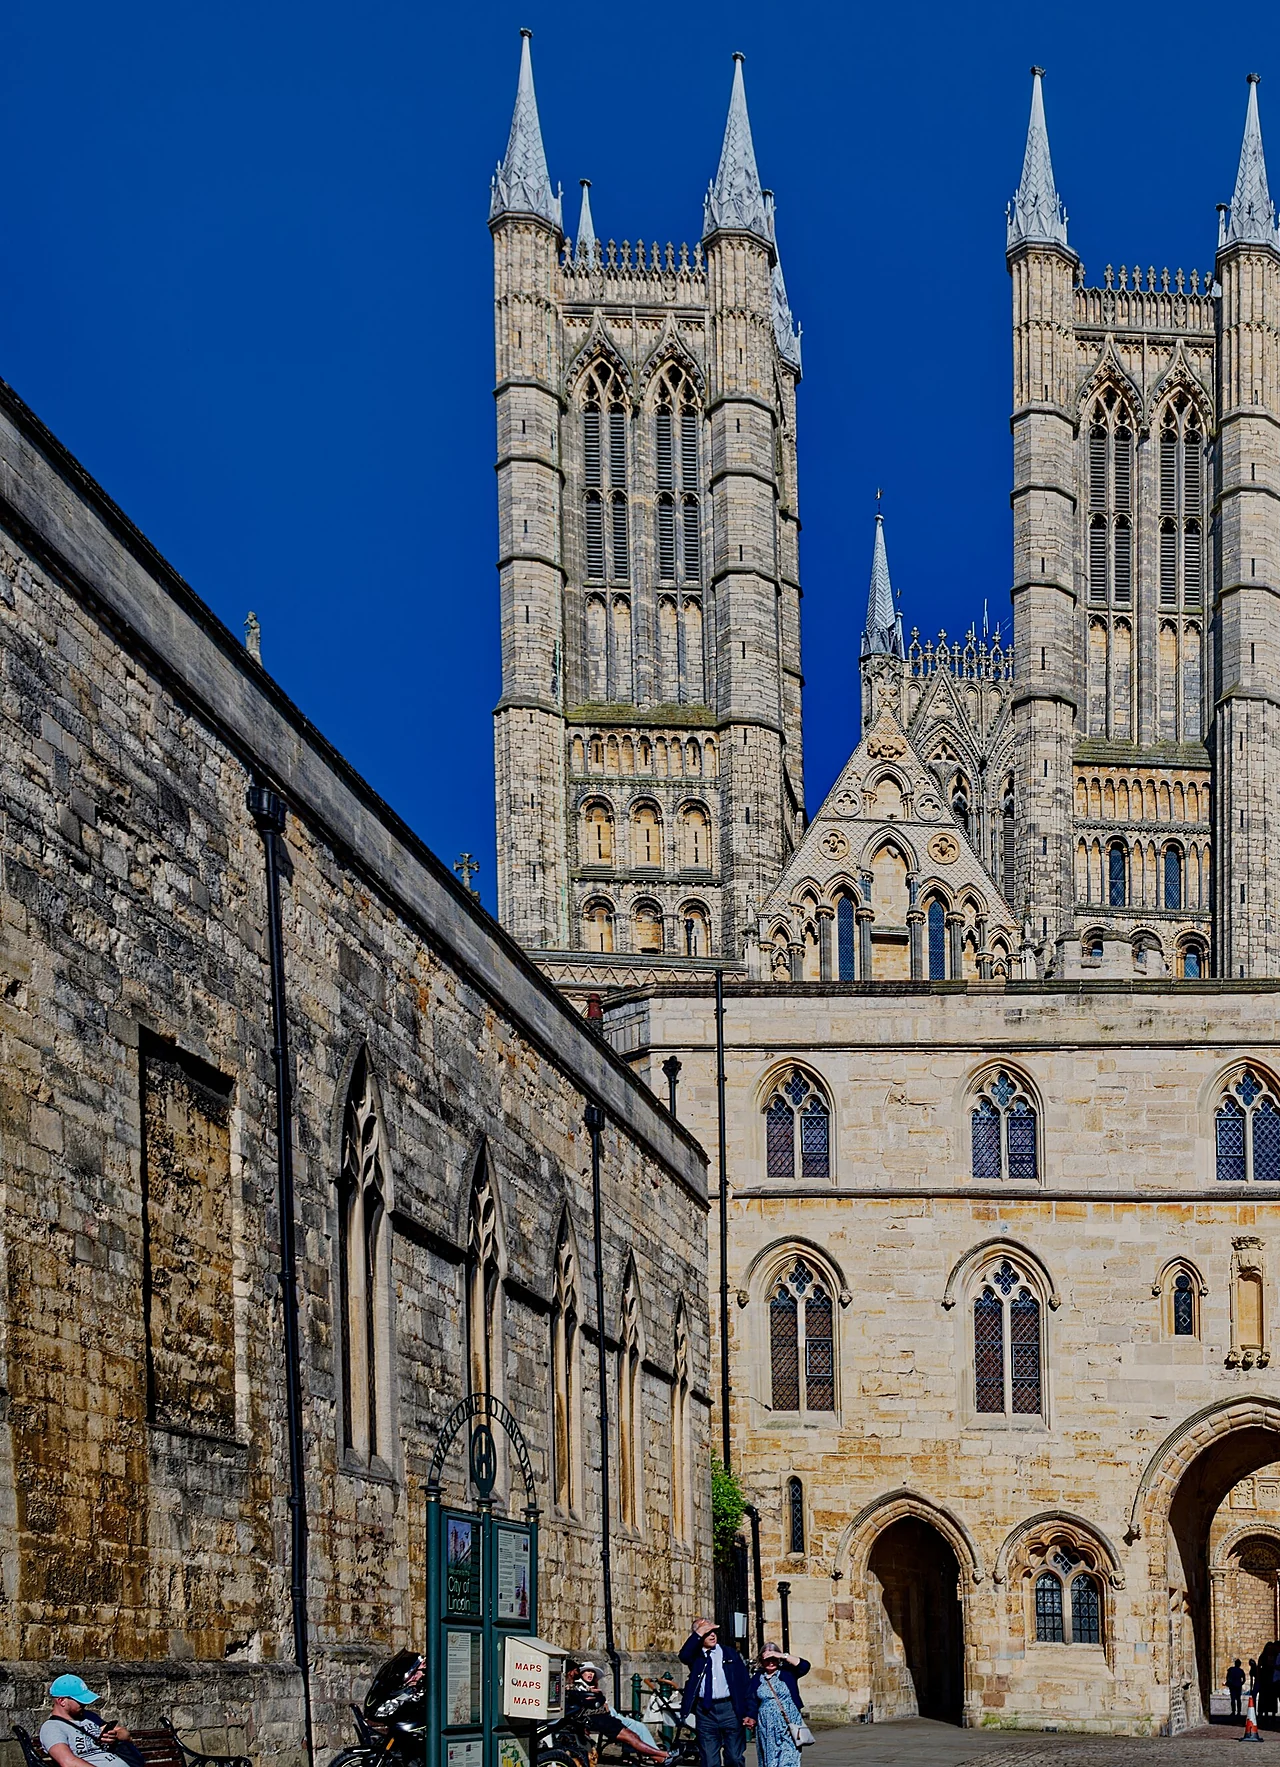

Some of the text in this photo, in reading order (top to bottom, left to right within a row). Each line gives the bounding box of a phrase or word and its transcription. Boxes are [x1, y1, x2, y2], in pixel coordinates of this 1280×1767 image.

[433, 1393, 481, 1471] WELCOME
[500, 1404, 535, 1493] LINCOLN
[448, 1576, 470, 1596] City of
[448, 1594, 471, 1611] Lincoln
[515, 1662, 542, 1673] MAPS
[515, 1679, 541, 1690] MAPS
[513, 1696, 541, 1707] MAPS
